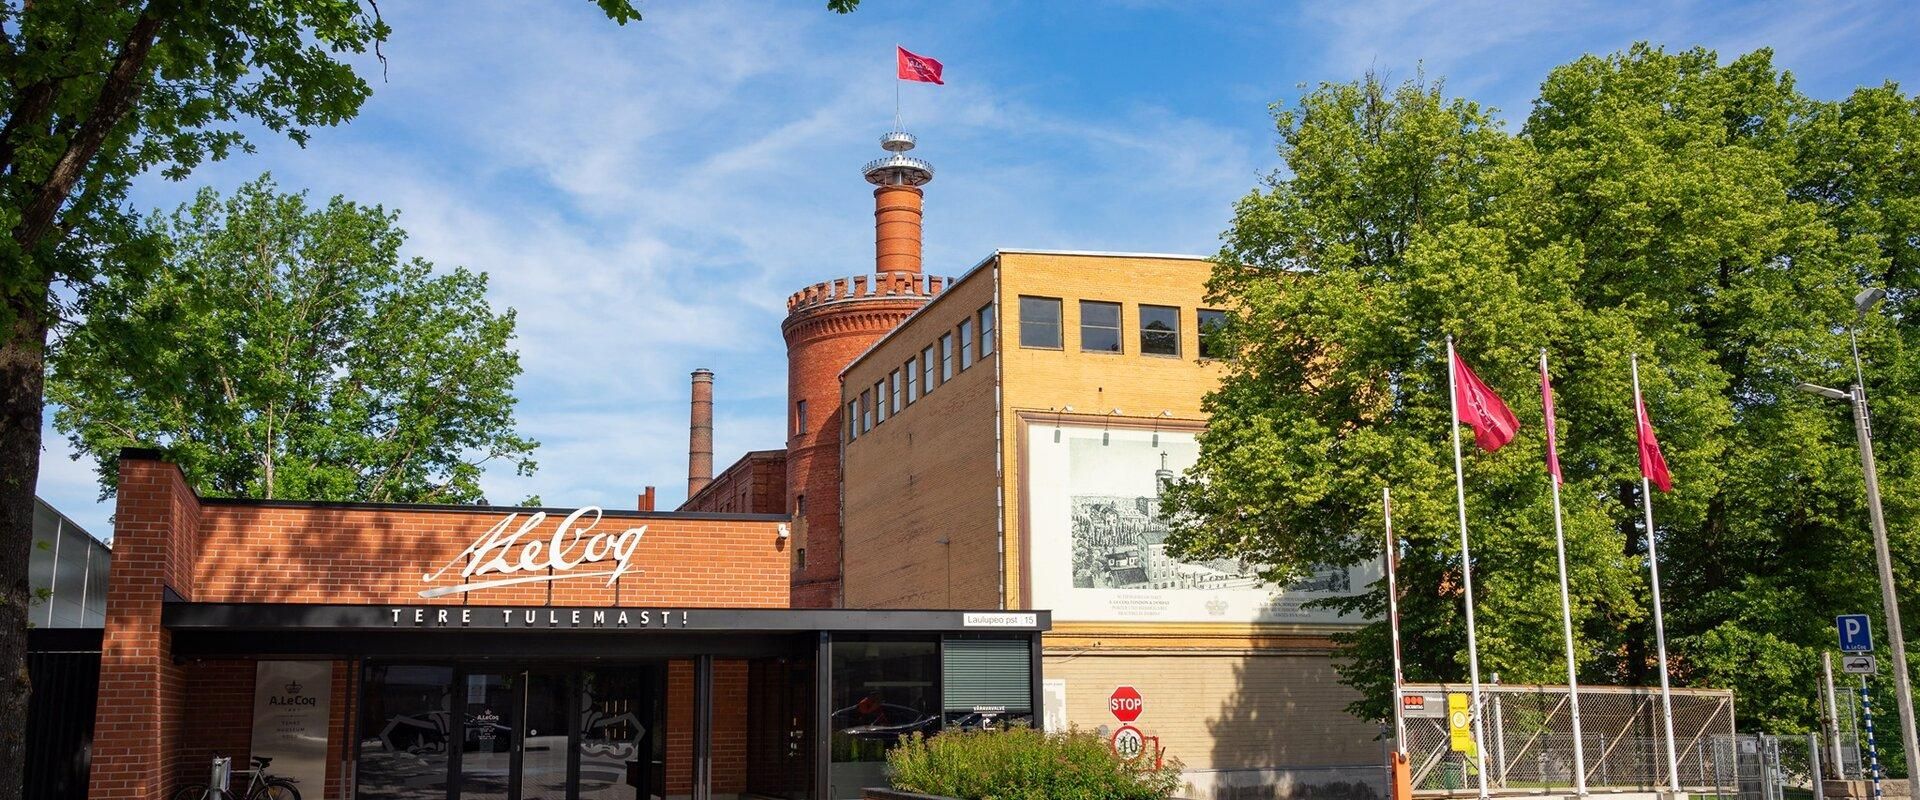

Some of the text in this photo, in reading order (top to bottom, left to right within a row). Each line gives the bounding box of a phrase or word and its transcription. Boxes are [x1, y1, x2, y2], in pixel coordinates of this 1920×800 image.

[391, 609, 688, 625] TERE TULEMAST!
[967, 615, 1034, 625] Laulupeo pst 15
[1845, 619, 1860, 643] P
[269, 695, 316, 707] A.LeCoq
[1111, 698, 1142, 710] STOP
[1120, 735, 1138, 753] 10
